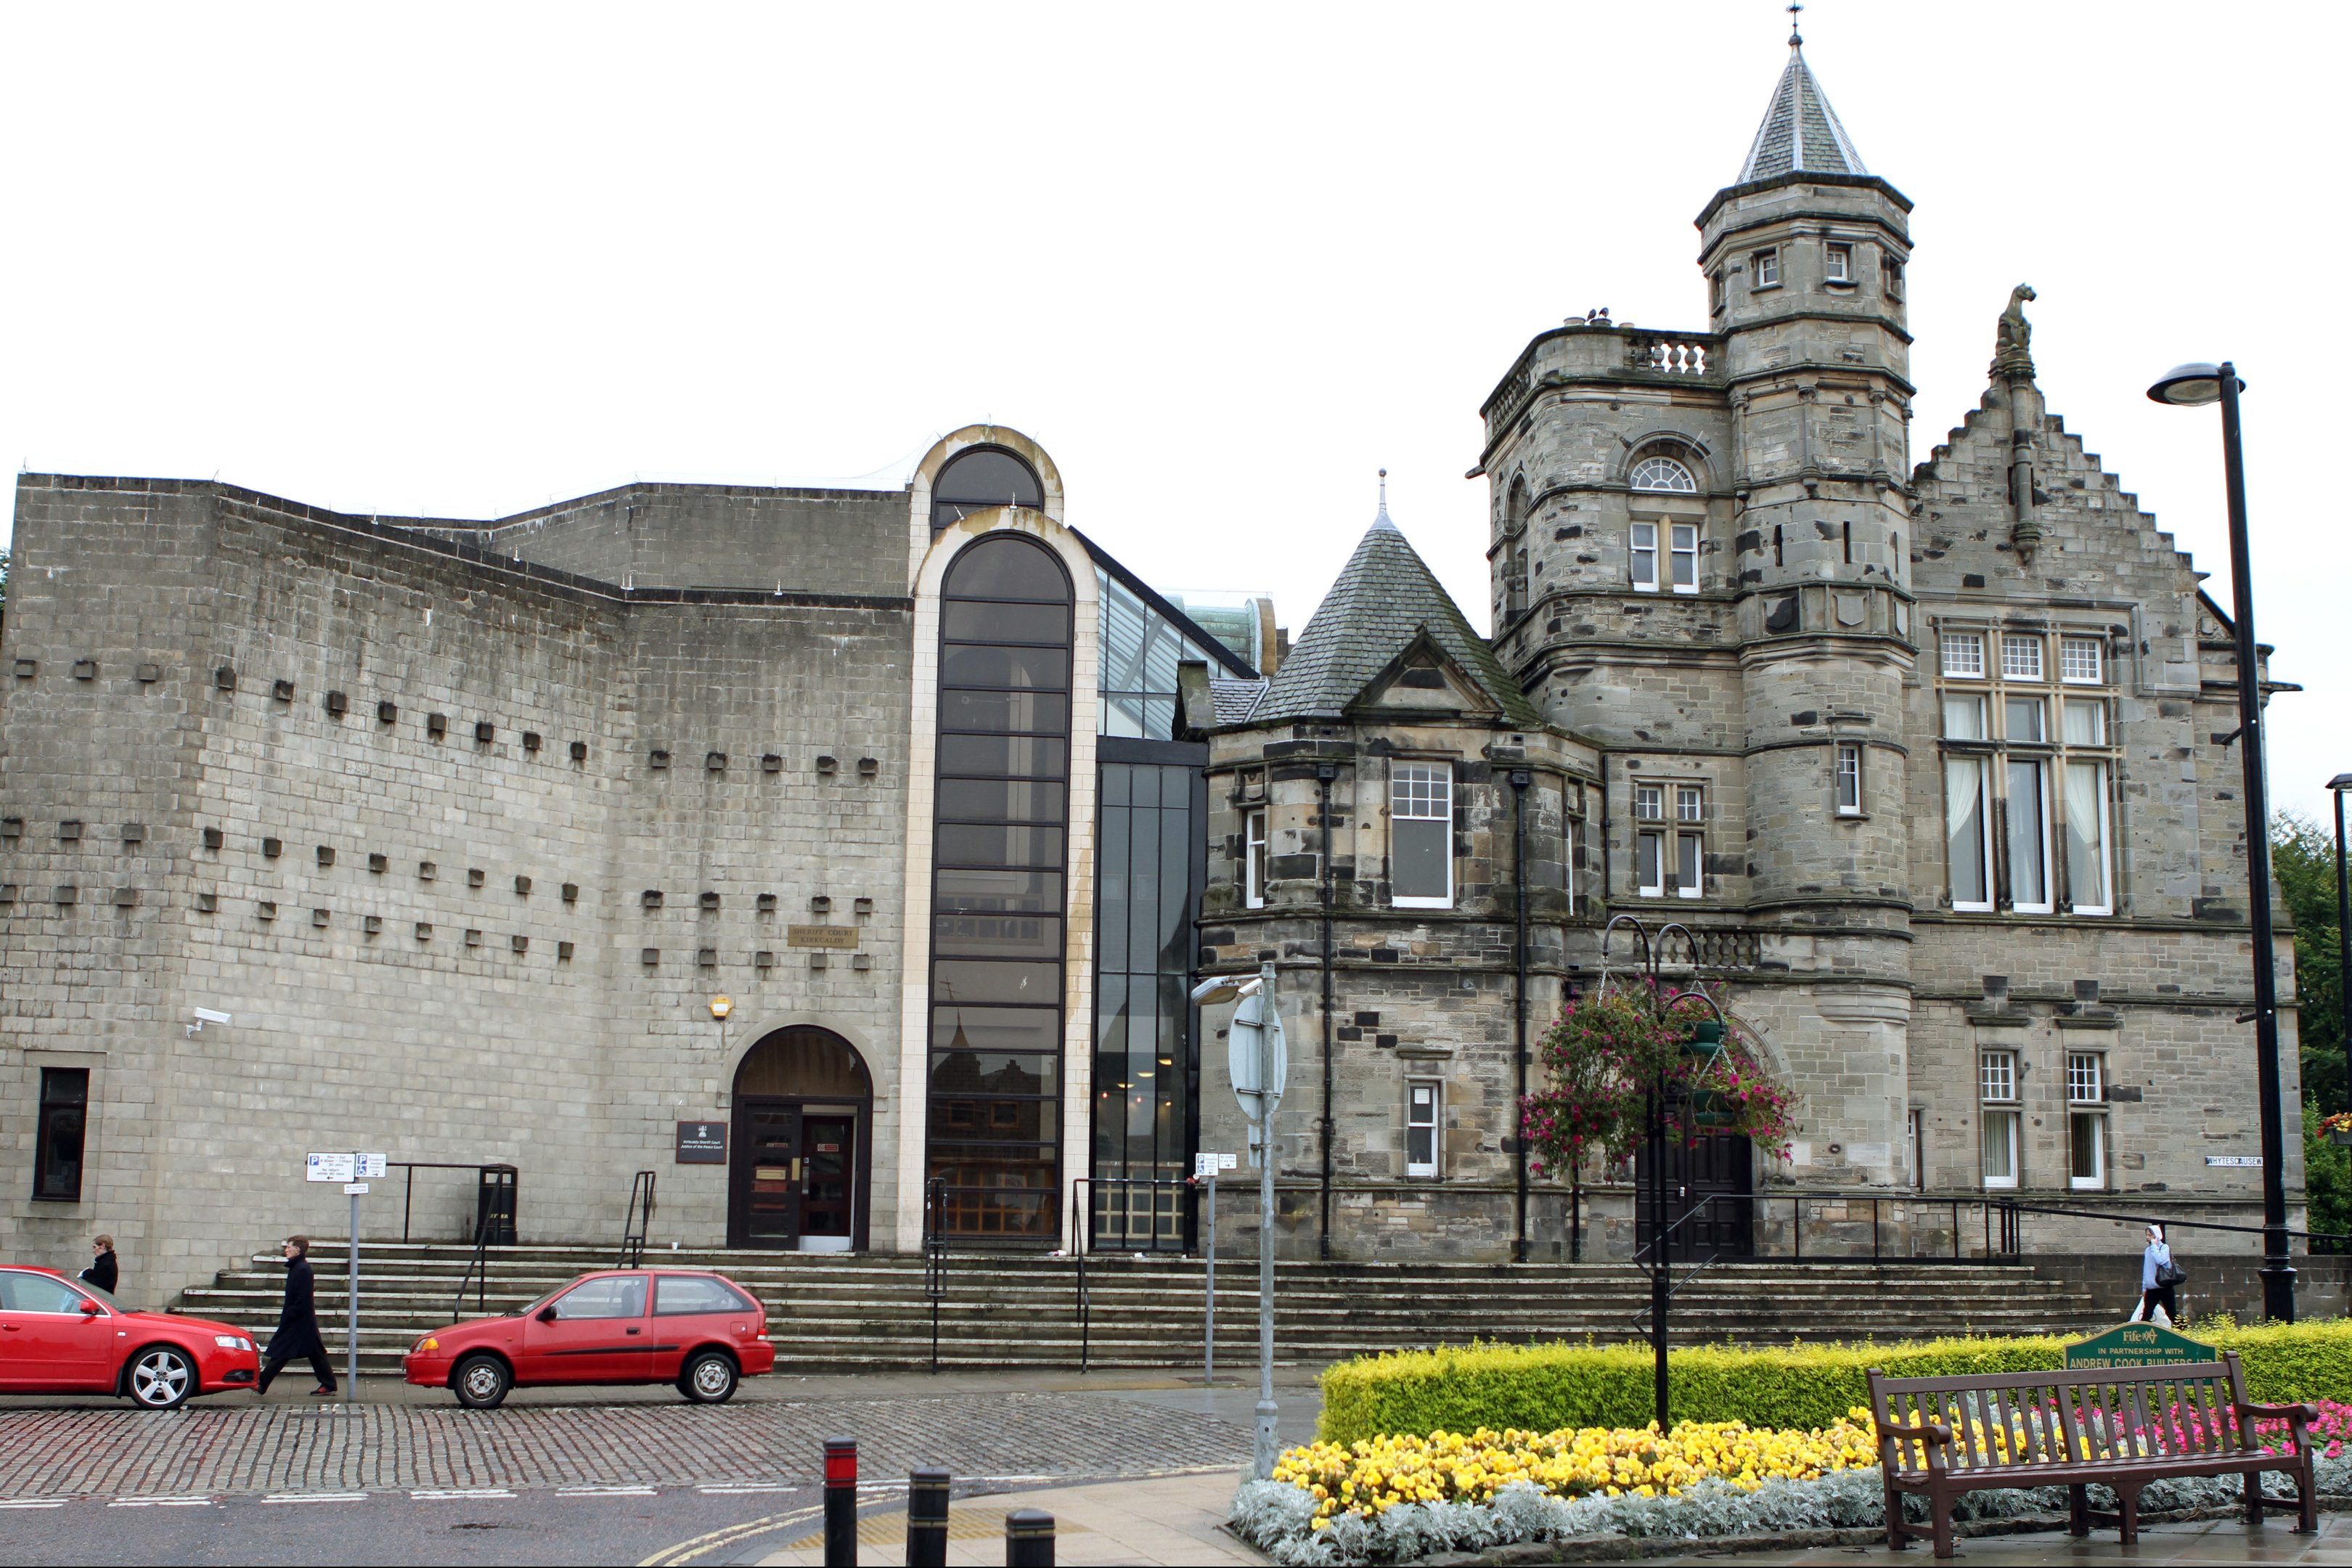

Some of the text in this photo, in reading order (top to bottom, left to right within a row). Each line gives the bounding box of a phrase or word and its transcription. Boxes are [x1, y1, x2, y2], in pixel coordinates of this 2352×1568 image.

[2123, 1331, 2141, 1342] Fife
[2070, 1358, 2110, 1369] ANDREW
[2115, 1358, 2141, 1368] COOK
